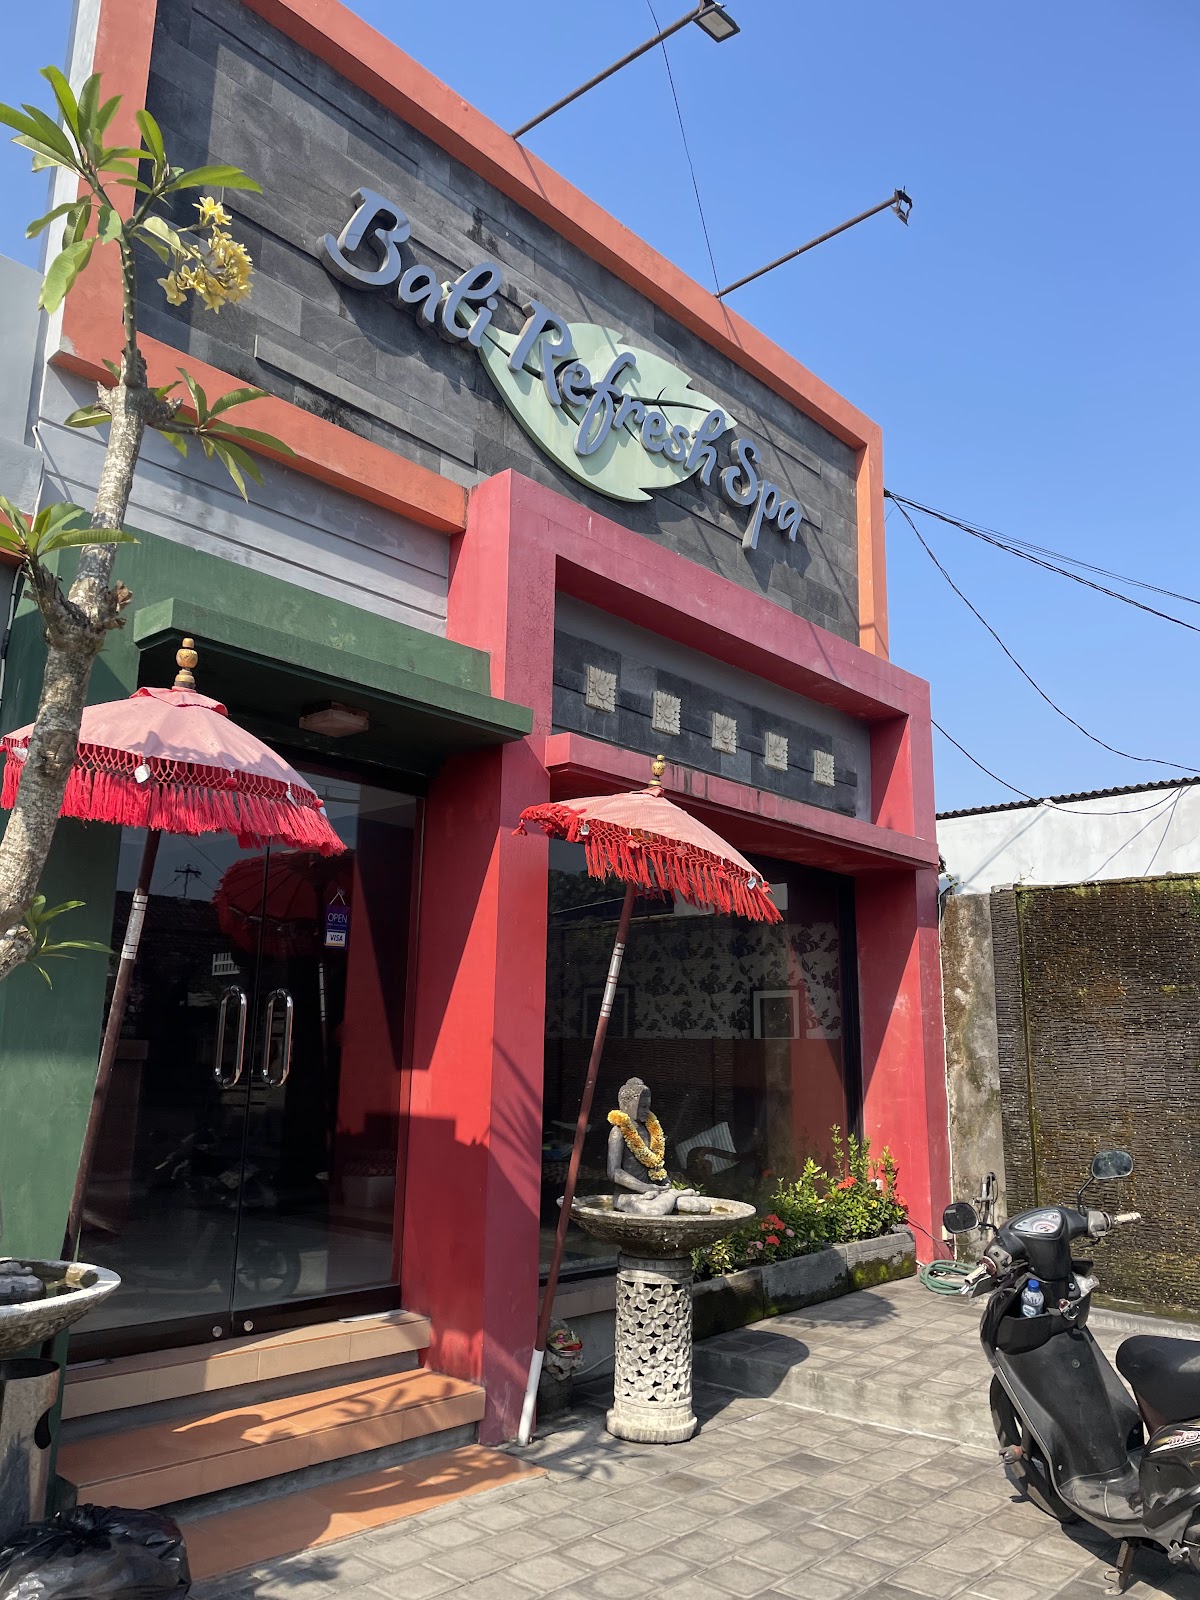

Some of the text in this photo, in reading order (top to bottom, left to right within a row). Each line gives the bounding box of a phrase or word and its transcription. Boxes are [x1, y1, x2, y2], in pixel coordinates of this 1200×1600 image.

[316, 186, 804, 551] Bali Refresh Spa
[328, 912, 347, 923] OPEN
[330, 934, 343, 942] VISA
